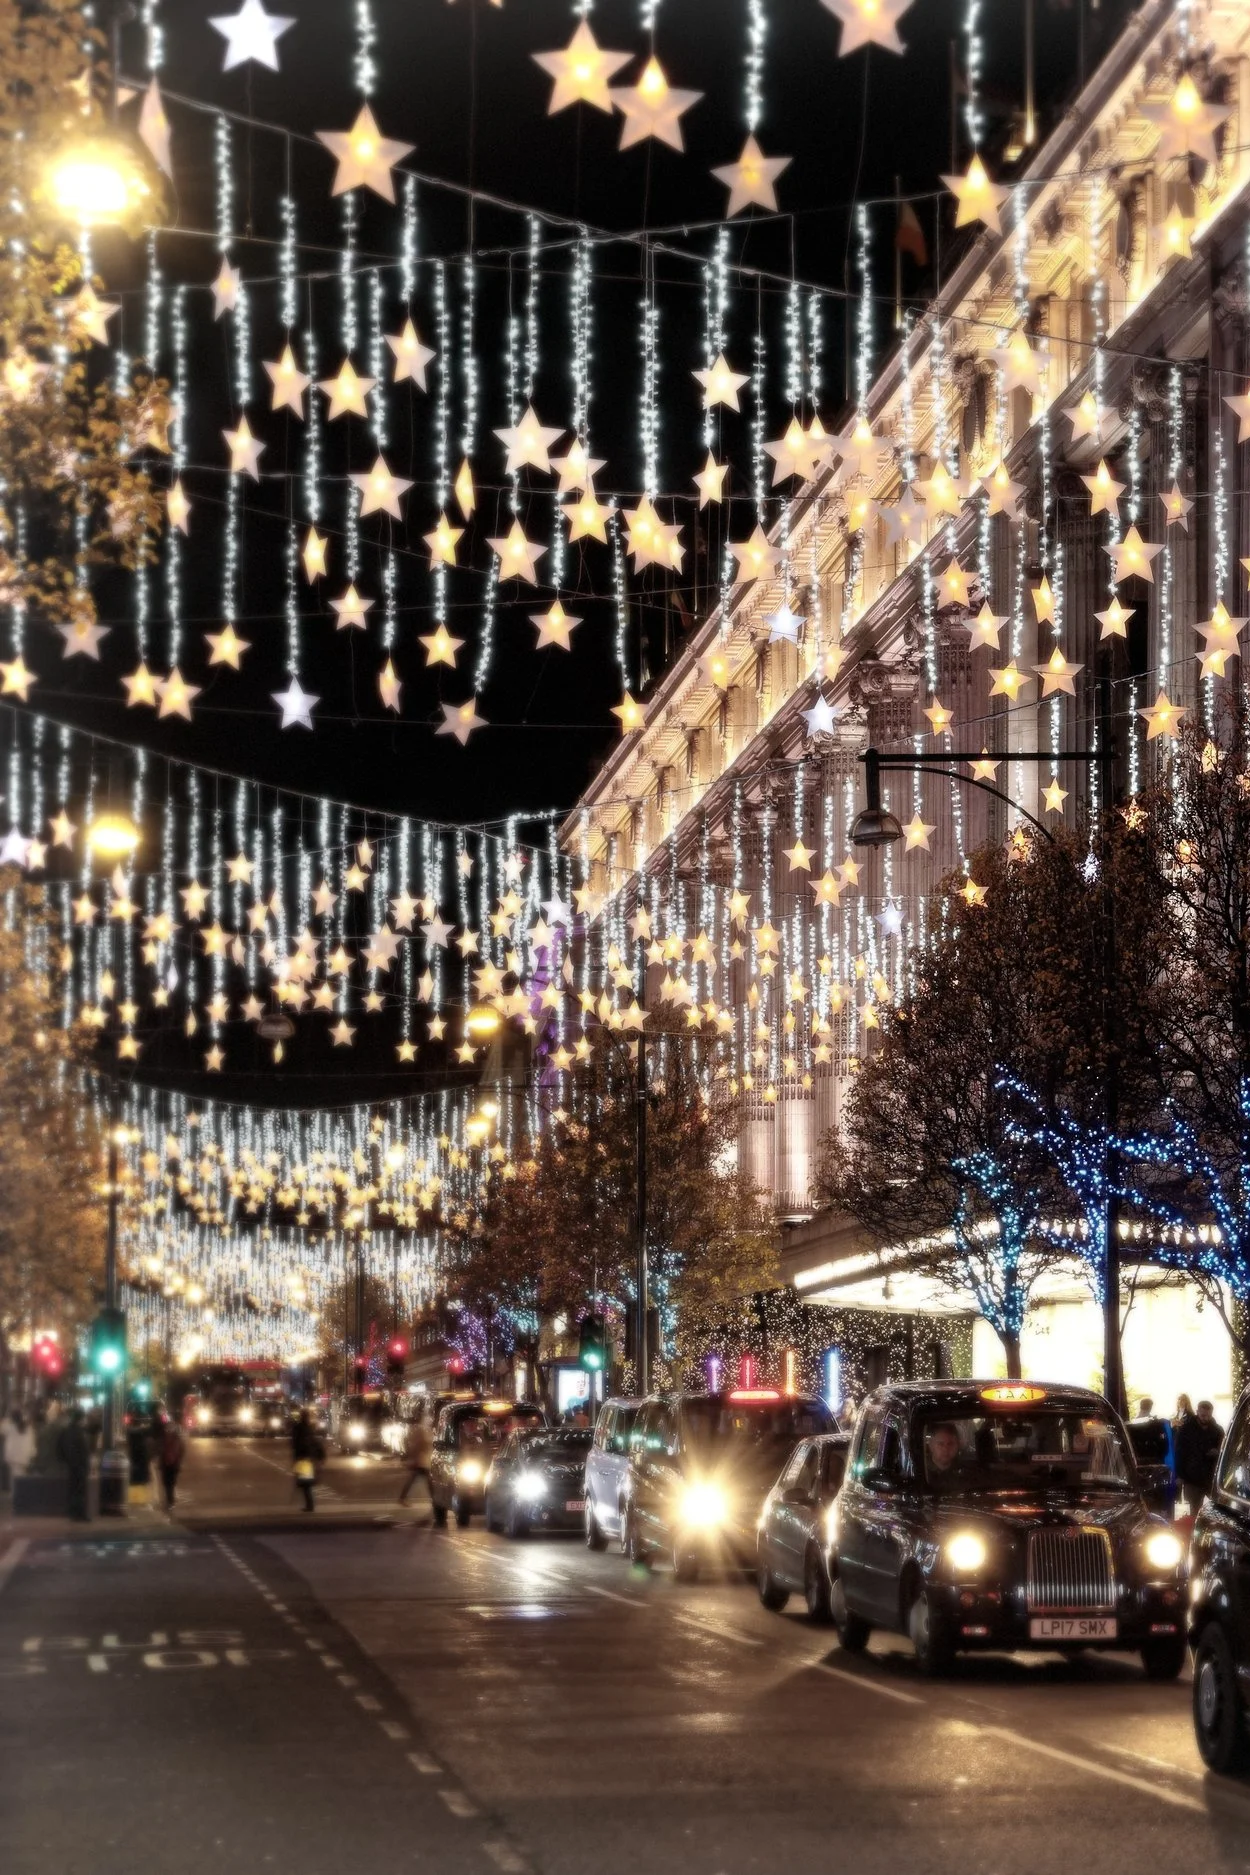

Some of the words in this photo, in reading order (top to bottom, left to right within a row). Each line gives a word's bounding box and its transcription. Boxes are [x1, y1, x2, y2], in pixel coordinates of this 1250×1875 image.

[995, 1389, 1034, 1399] TAXI
[1041, 1621, 1075, 1635] LP17
[1079, 1621, 1107, 1635] SMX
[22, 1630, 245, 1652] BUS
